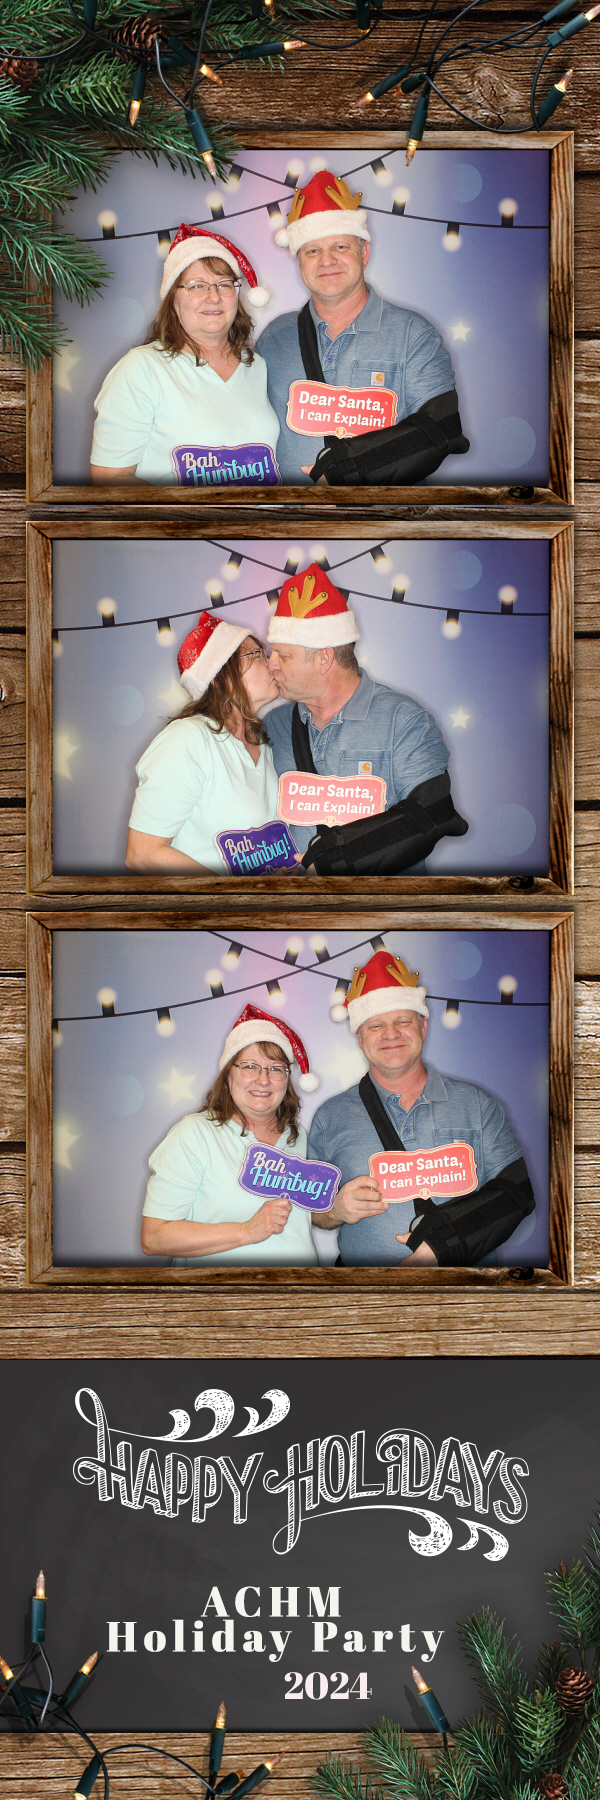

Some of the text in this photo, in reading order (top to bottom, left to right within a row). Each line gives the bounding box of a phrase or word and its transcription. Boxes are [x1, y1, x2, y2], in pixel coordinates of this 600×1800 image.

[298, 391, 385, 415] Dear Santa,
[300, 408, 386, 428] I can Explain!
[181, 452, 222, 469] Bah
[186, 456, 271, 486] Humbug!
[288, 782, 374, 802] Dear Santa,
[289, 799, 376, 816] I can Explain!
[224, 836, 256, 857] Bah
[232, 833, 291, 875] Humbug!
[252, 1151, 287, 1174] Bah
[378, 1155, 463, 1175] Dear Santa,
[249, 1166, 332, 1201] Humbug!
[383, 1169, 466, 1190] I can Explain!
